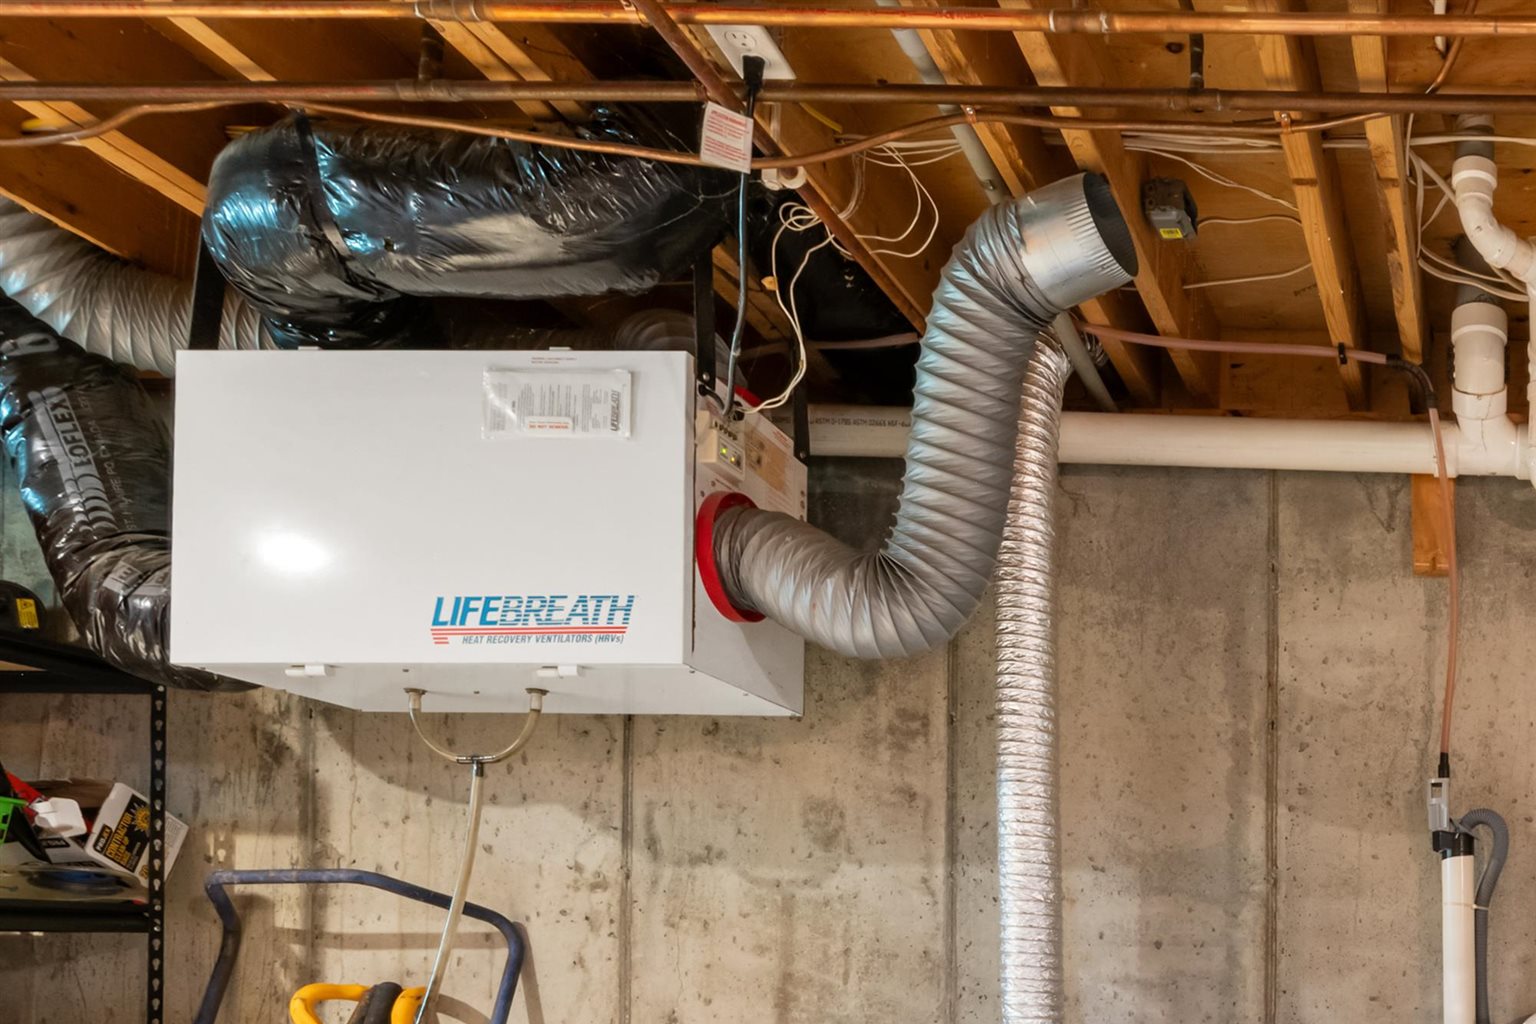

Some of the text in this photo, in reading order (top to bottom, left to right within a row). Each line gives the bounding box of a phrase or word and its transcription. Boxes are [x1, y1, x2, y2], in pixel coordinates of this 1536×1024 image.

[431, 595, 636, 626] LIFEBREATH
[462, 634, 625, 645] HEAT RECOVERY VENTILATORS (HRVs)
